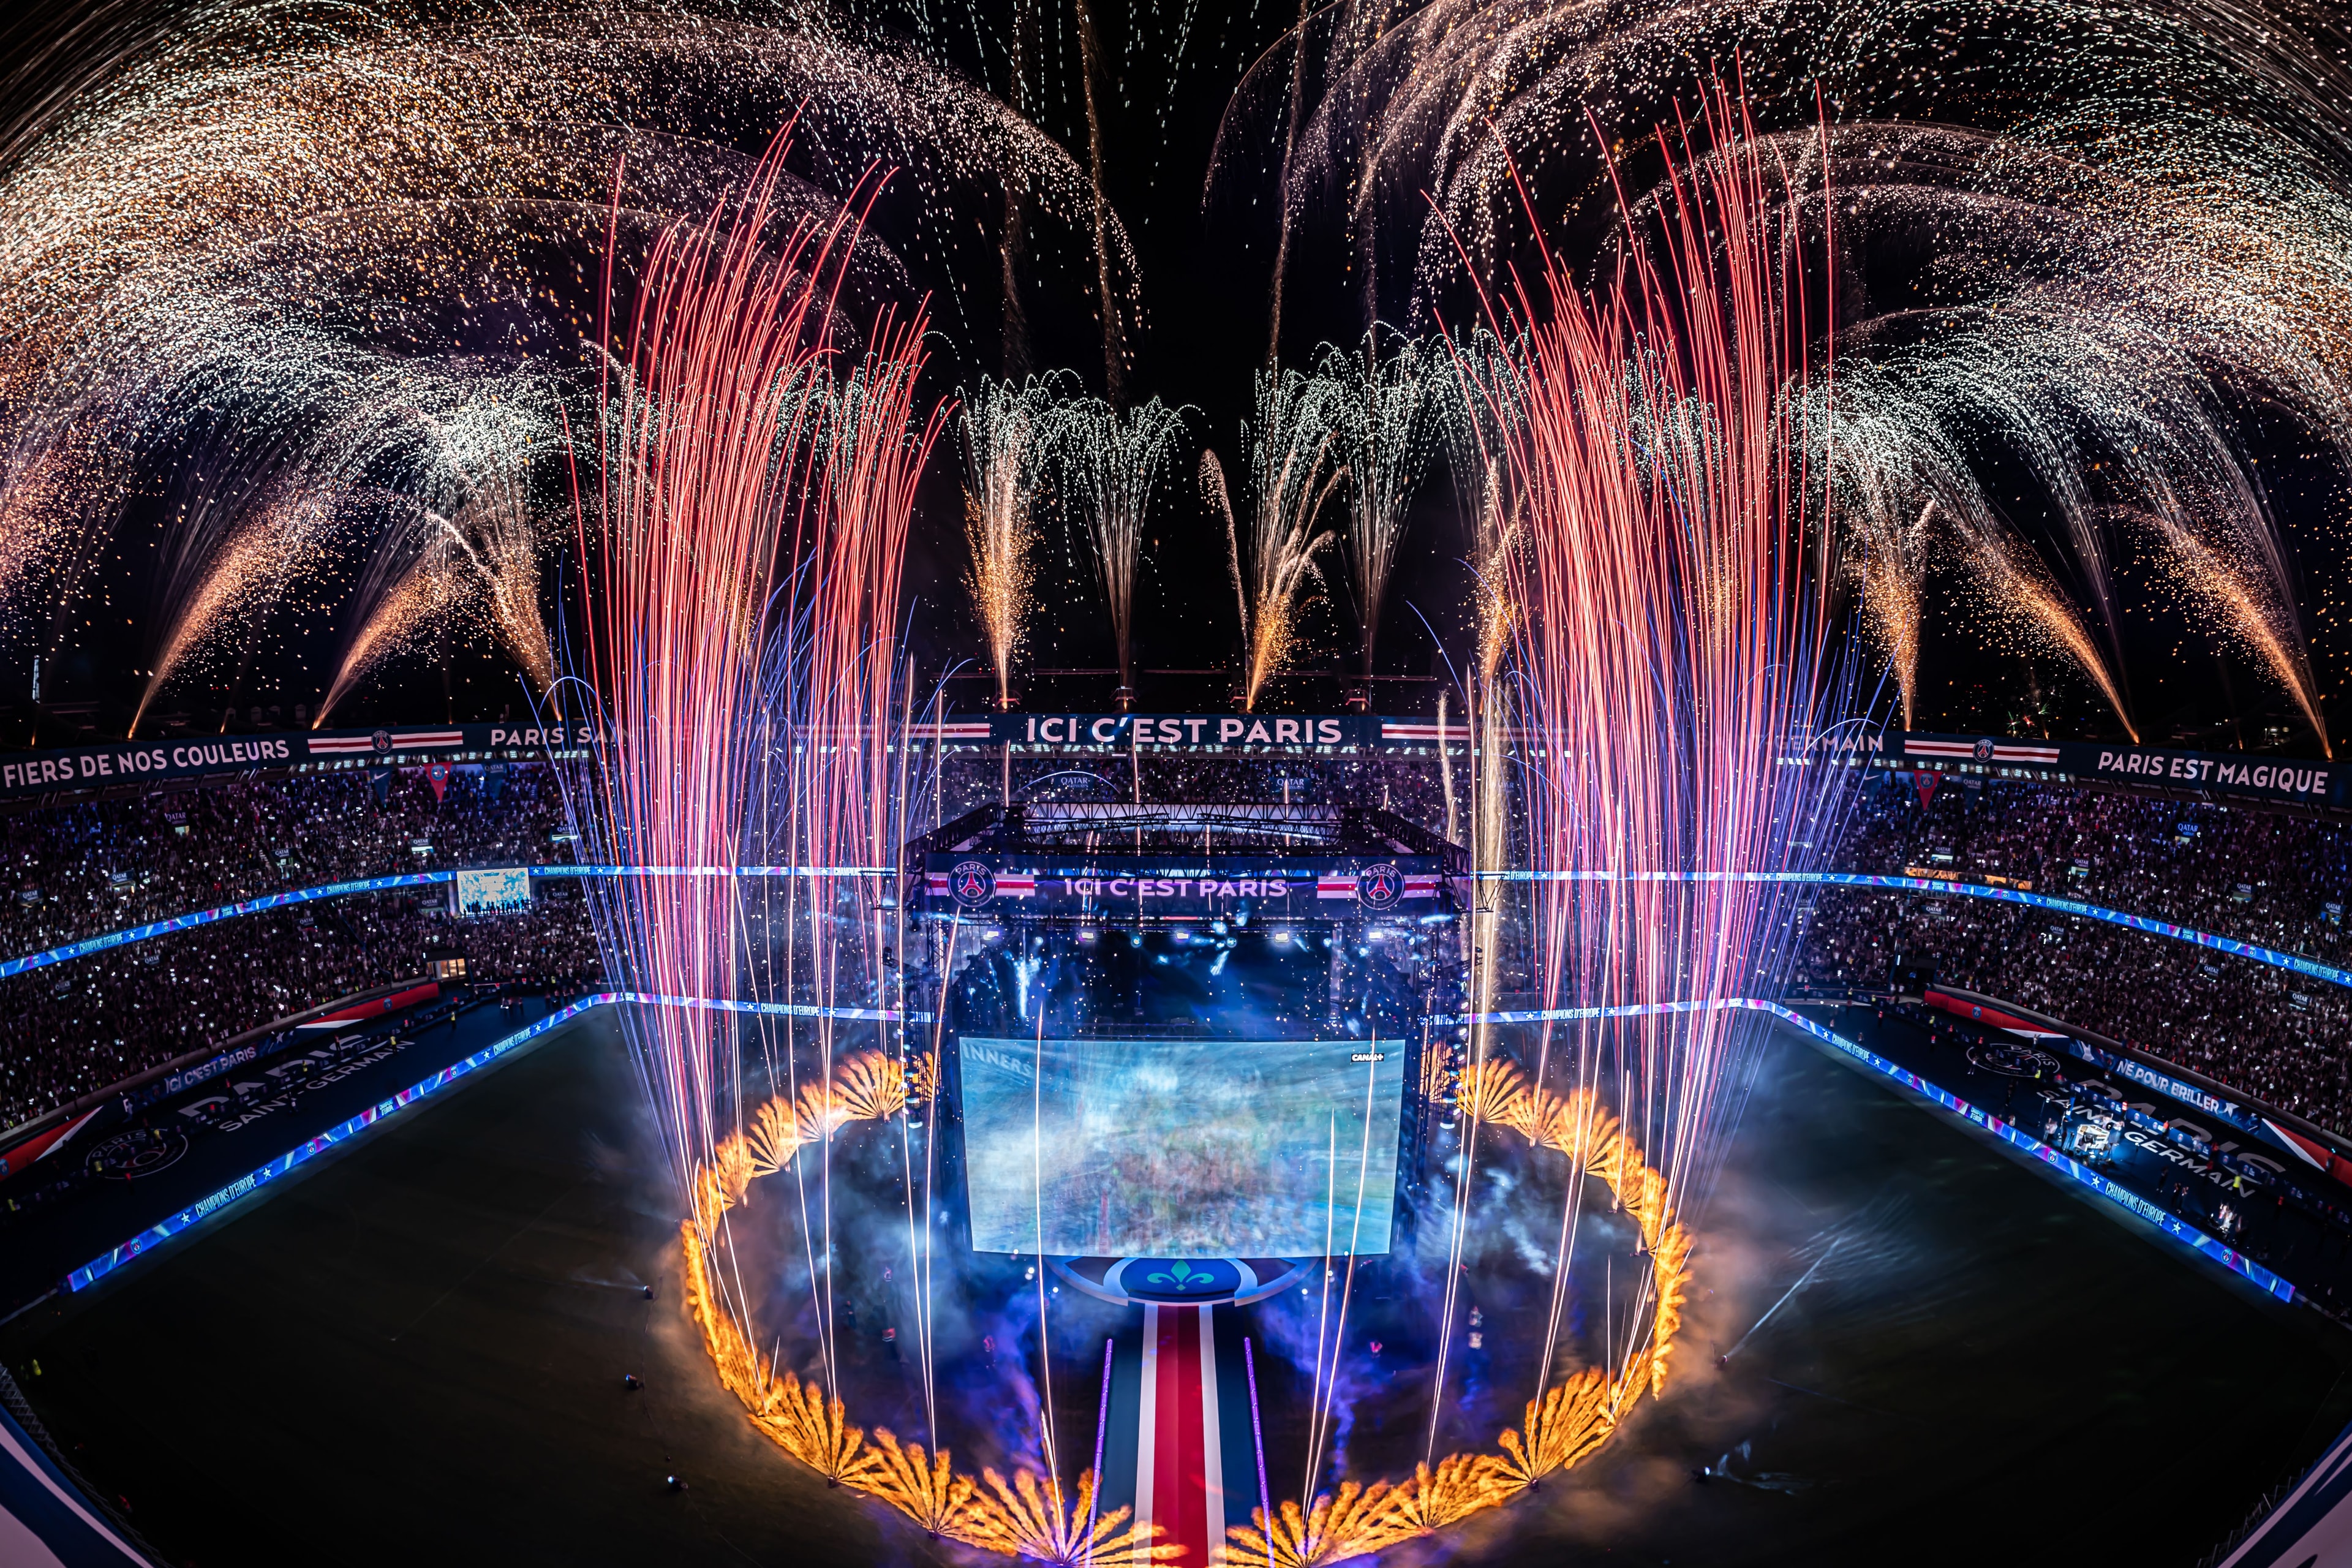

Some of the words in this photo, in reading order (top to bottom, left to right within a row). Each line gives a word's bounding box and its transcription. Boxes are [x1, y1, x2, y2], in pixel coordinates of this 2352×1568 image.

[491, 726, 565, 746] PARIS
[1027, 717, 1076, 742] ICI
[1092, 717, 1207, 743] C'EST
[1221, 718, 1342, 744] PARIS
[3, 757, 74, 788] FIERS
[80, 754, 113, 777] DE
[118, 748, 167, 773] NOS
[173, 740, 290, 767] COULEURS
[2098, 752, 2165, 775] PARIS
[2169, 758, 2214, 780] EST
[2217, 763, 2328, 794] MAGIQUE
[166, 812, 186, 821] QATAR
[2178, 823, 2198, 832] QATAR
[956, 864, 986, 875] PARIS
[1366, 866, 1396, 878] PARIS
[1066, 878, 1101, 896] ICI
[1109, 878, 1192, 897] C'EST
[1199, 879, 1287, 897] PARIS
[2292, 993, 2308, 1002] QATAR
[761, 1002, 793, 1014] CHAMPIONS
[793, 1005, 820, 1017] D'EUROPE
[1541, 1009, 1574, 1020] CHAMPIONS
[1574, 1007, 1600, 1019] D'EUROPE
[962, 1042, 1033, 1079] INNERS
[2011, 1046, 2055, 1066] PARIS
[165, 1076, 181, 1094] ICI
[219, 1046, 257, 1071] PARIS
[2117, 1060, 2135, 1077] NÉ
[2135, 1068, 2169, 1091] POUR
[2171, 1082, 2219, 1114] BRILLER
[92, 1131, 147, 1158] PARIS
[195, 1189, 230, 1218] CHAMPIONS
[228, 1174, 257, 1200] D'EUROPE
[2105, 1182, 2139, 1211] CHAMPIONS
[2136, 1199, 2166, 1226] D'EUROPE
